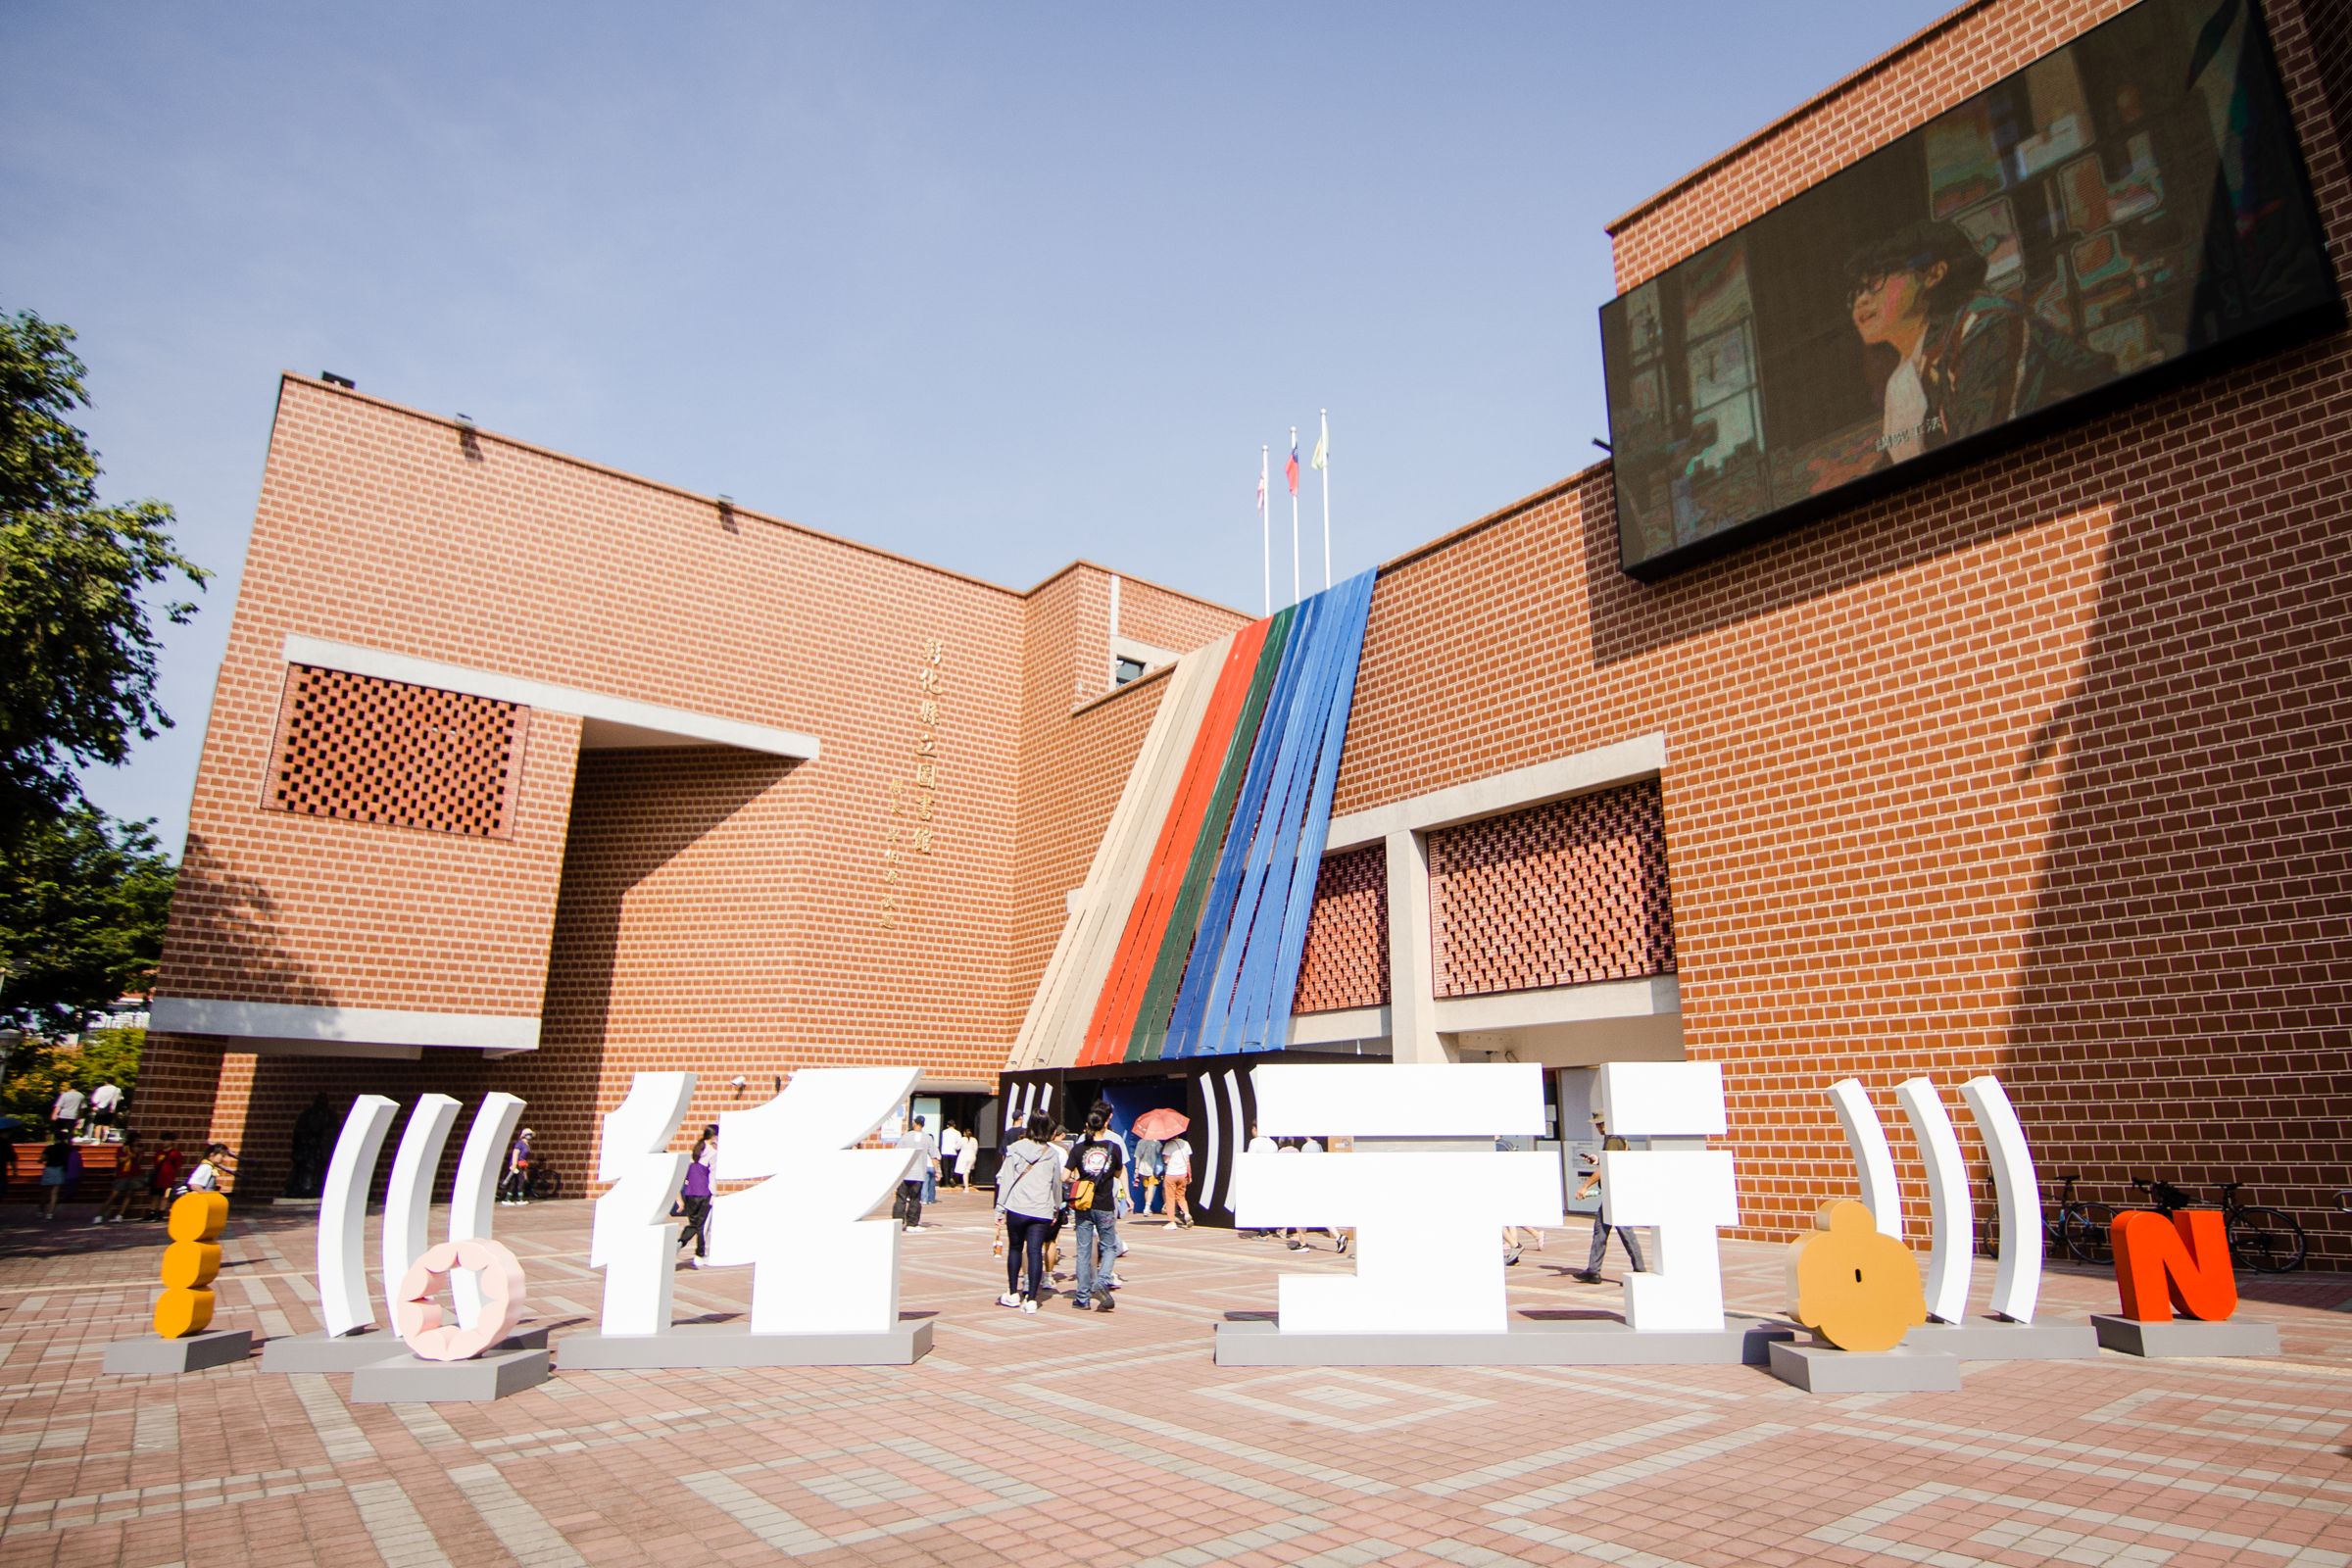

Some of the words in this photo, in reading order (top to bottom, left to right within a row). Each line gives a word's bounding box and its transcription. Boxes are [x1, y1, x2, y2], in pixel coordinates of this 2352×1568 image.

[912, 637, 943, 856] 彰化縣立圖書館
